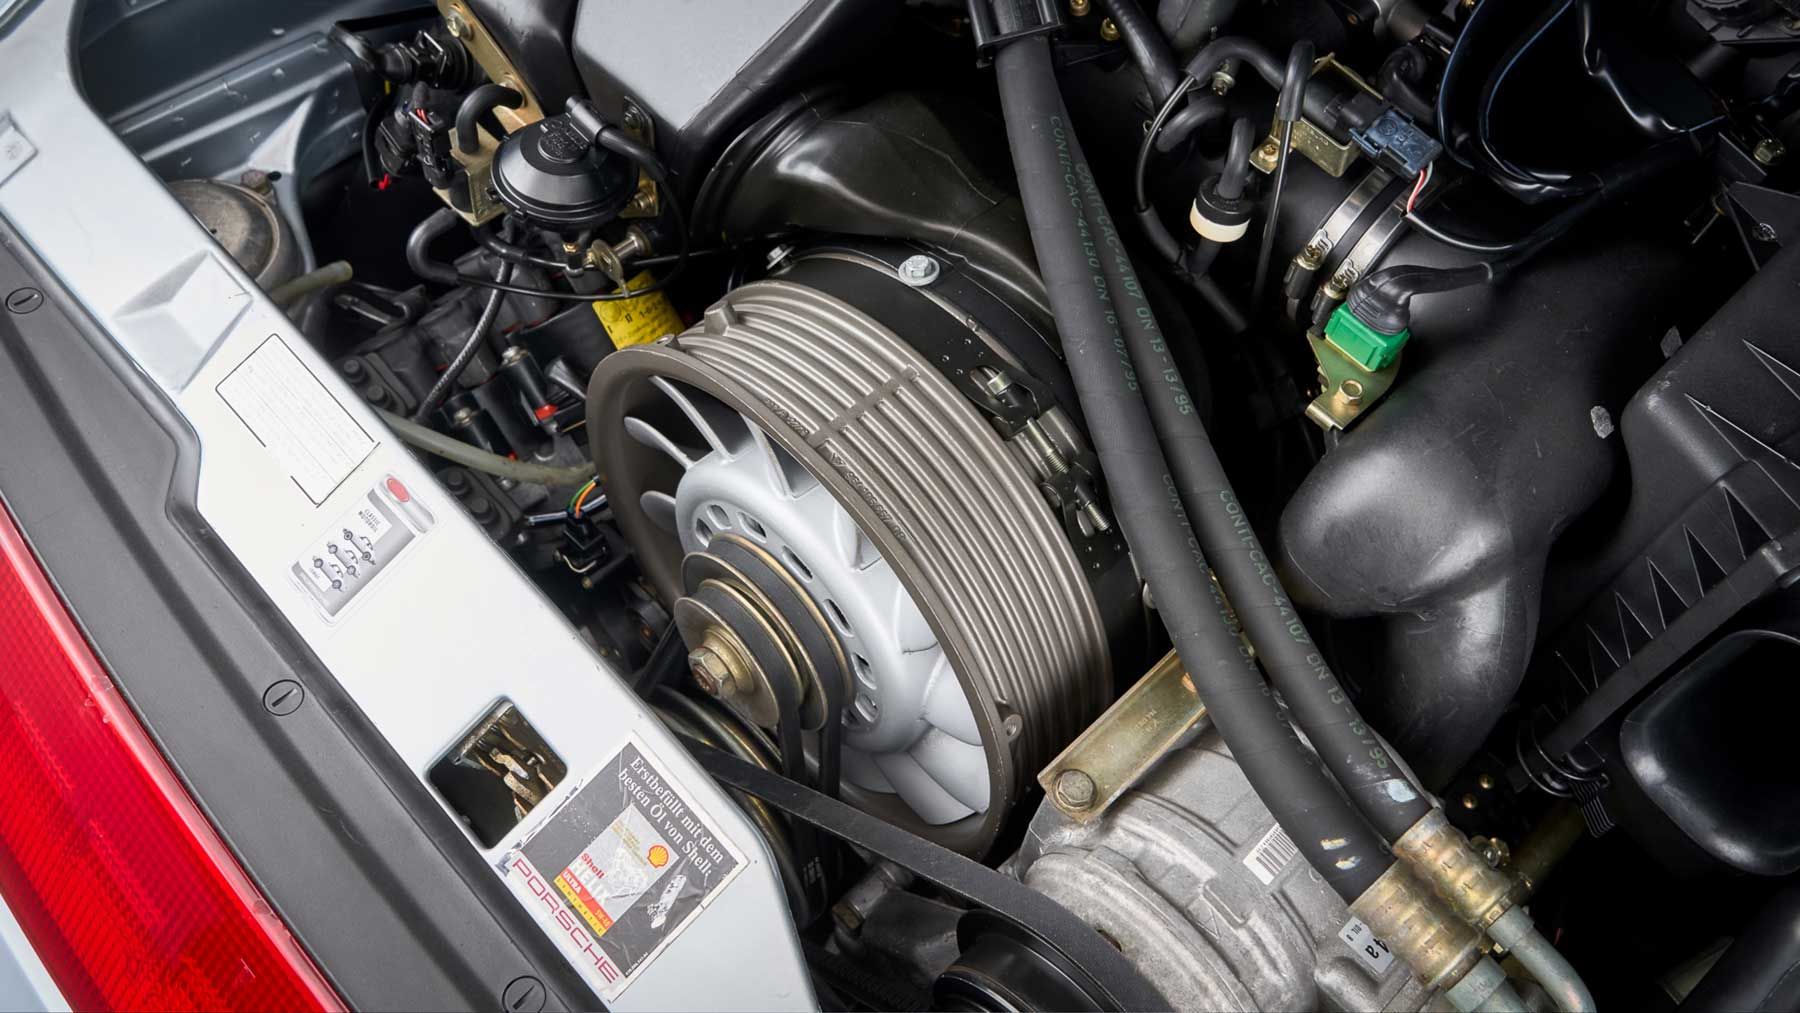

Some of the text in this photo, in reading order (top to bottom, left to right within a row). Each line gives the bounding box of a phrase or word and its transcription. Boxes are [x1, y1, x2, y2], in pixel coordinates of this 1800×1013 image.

[618, 768, 651, 808] besten
[650, 803, 667, 823] Öl
[664, 824, 684, 845] von
[630, 757, 724, 863] Erstbefüllt mit dem
[561, 870, 581, 893] ULTRA
[581, 853, 604, 878] Shell
[512, 858, 619, 984] PORSCHE
